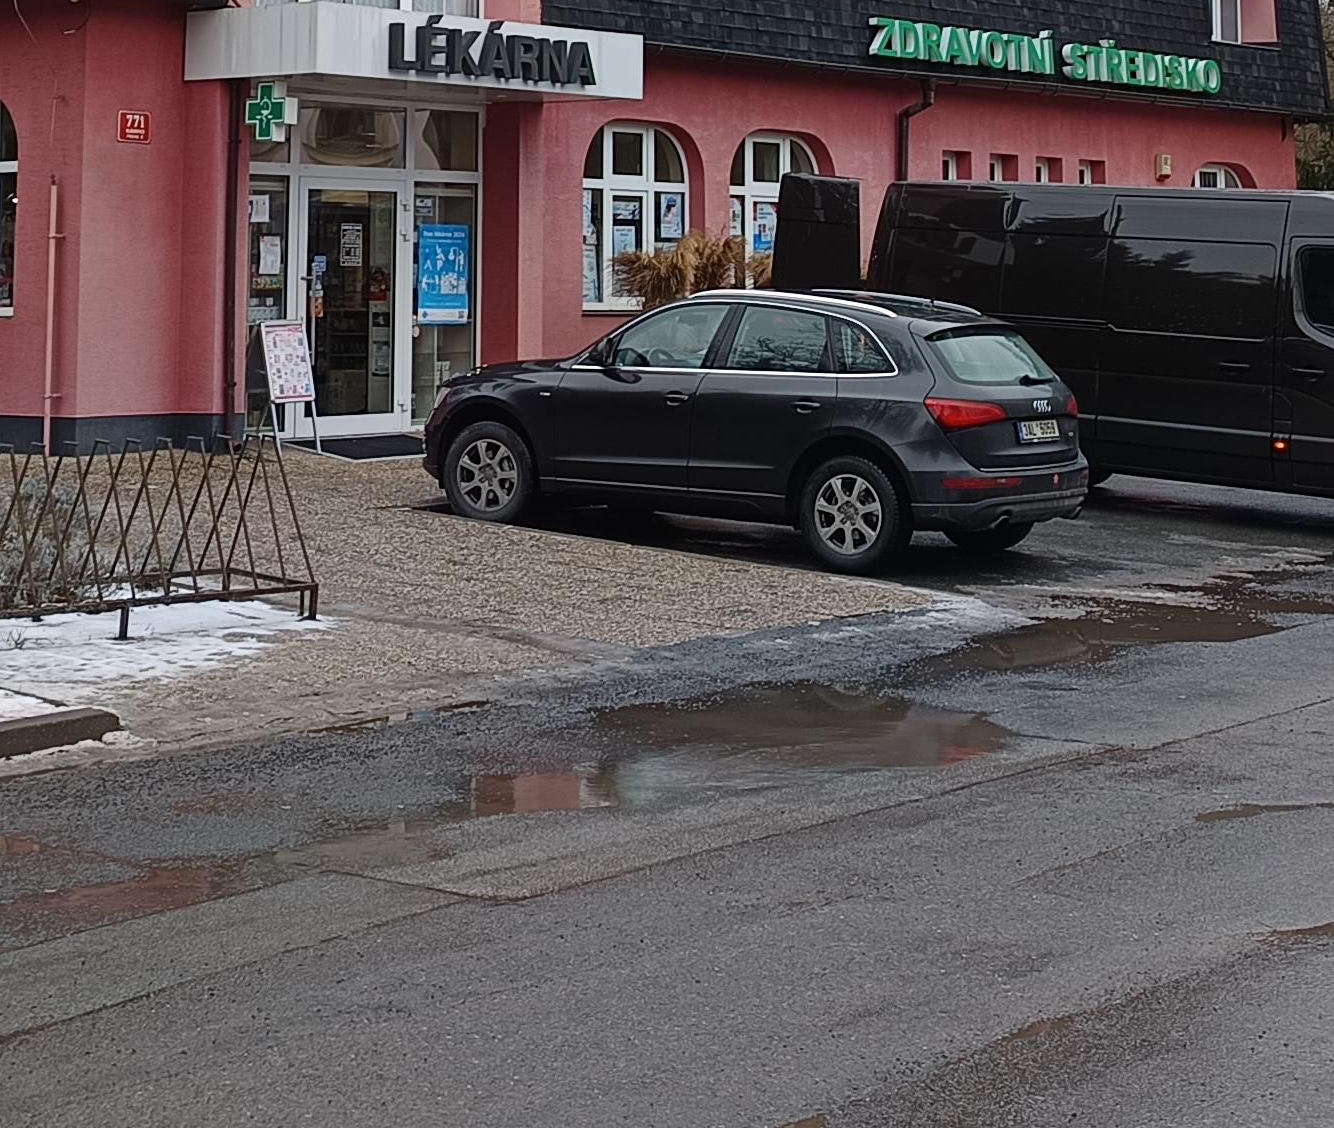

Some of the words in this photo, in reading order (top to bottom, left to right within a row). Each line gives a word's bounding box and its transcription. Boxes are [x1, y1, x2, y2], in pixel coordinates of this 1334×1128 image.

[388, 14, 597, 88] LÉKÁRNA
[868, 16, 1055, 75] ZDRAVOTNÍ
[1061, 39, 1222, 94] STŘEDISKO
[126, 114, 145, 129] 771
